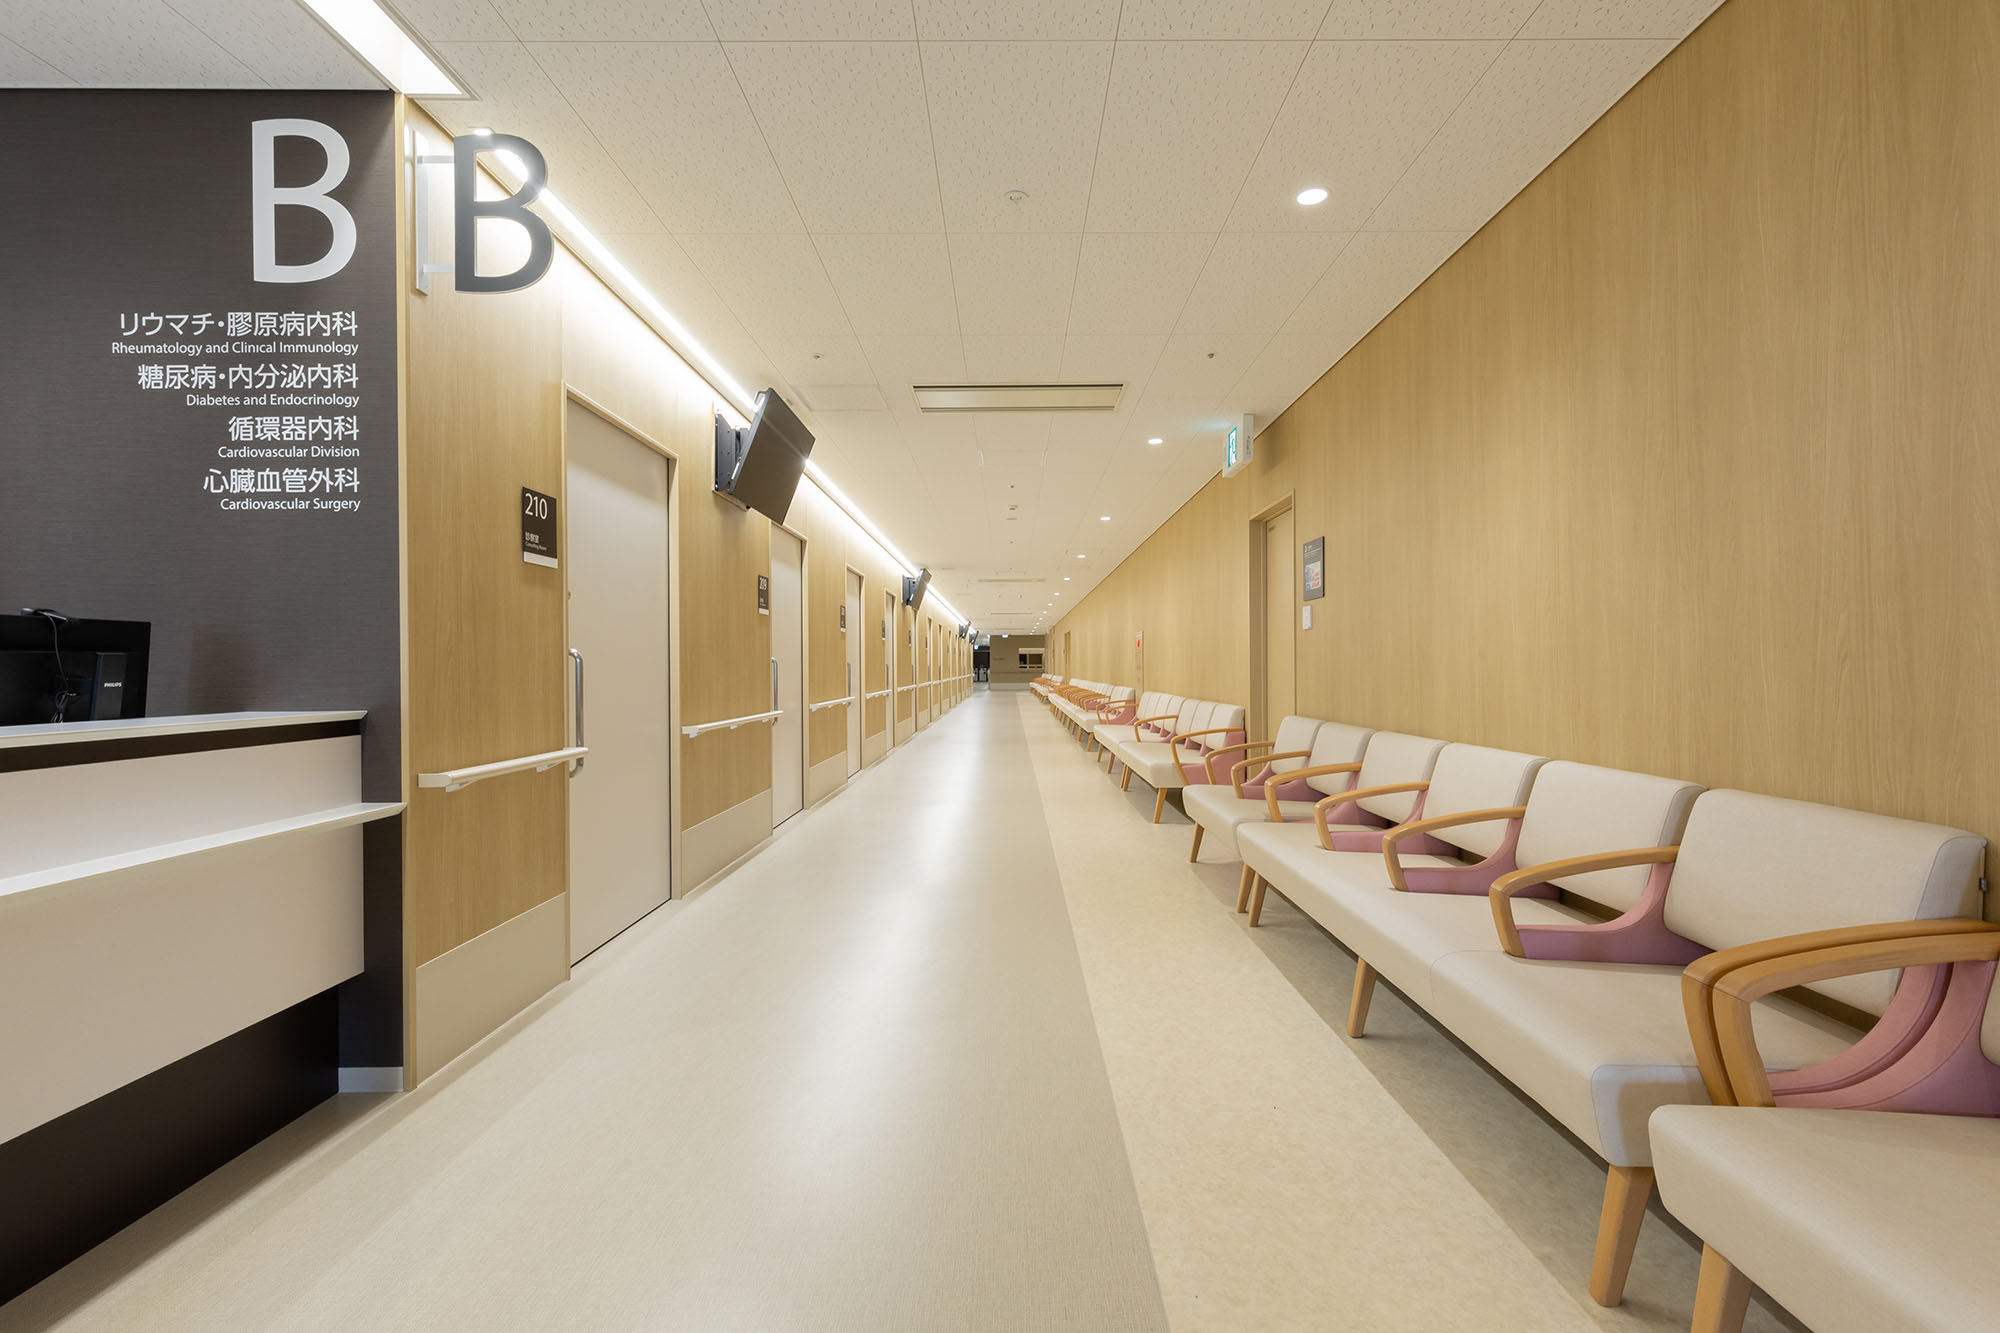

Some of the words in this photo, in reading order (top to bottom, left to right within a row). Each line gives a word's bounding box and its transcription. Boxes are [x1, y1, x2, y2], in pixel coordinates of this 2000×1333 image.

[251, 119, 357, 283] B
[454, 134, 555, 294] B
[120, 311, 359, 337] リウマチ・膠原病内科
[111, 341, 203, 357] Rheumatology
[205, 341, 229, 354] and
[232, 341, 277, 354] Clinical
[279, 341, 360, 357] Immunology
[137, 363, 359, 390] 糖尿病・内分泌内科
[186, 393, 241, 407] Diabetes
[243, 393, 267, 407] and
[269, 393, 360, 409] Endocrinology
[228, 415, 360, 442] 循環器内科
[217, 446, 309, 458] Cardiovascular
[311, 446, 360, 458] Division
[202, 467, 360, 494] 心臓血管外科
[219, 498, 311, 511] Cardiovascular
[312, 498, 361, 513] Surgery
[525, 493, 547, 520] 210
